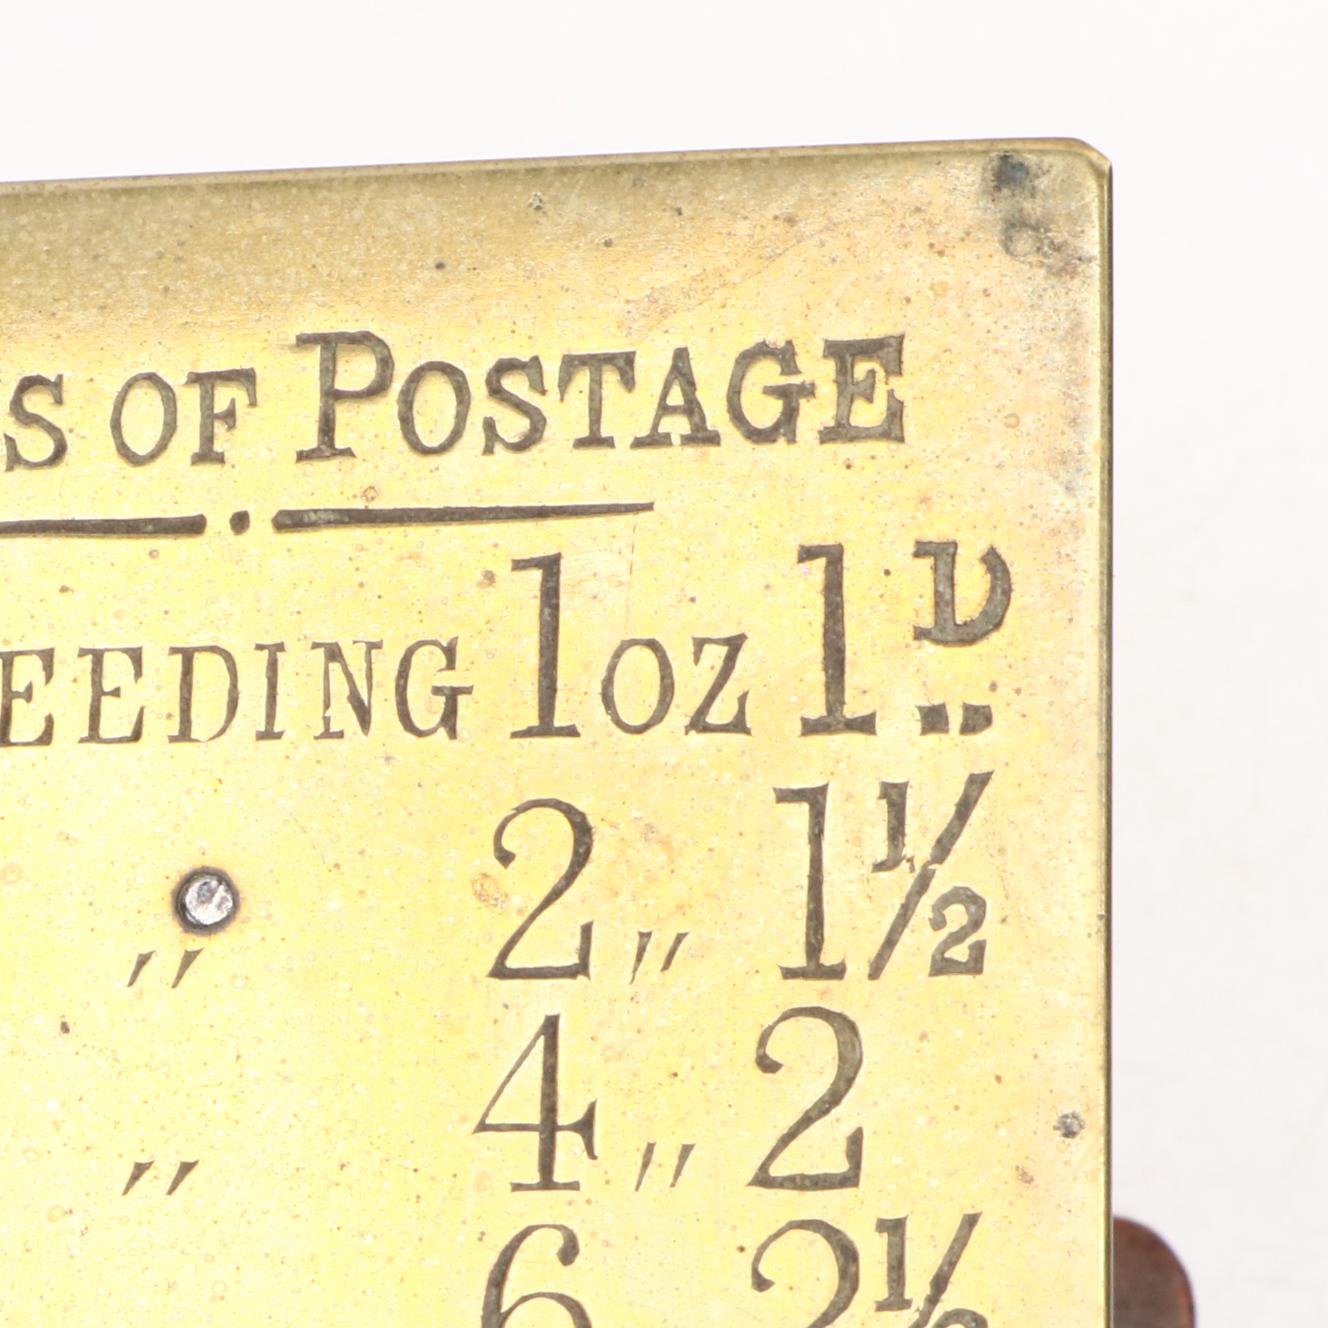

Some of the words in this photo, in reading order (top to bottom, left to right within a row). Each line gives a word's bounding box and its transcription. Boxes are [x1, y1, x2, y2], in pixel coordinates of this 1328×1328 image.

[110, 367, 258, 467] OF
[288, 331, 907, 464] POSTAGE
[747, 1006, 864, 1192] 2
